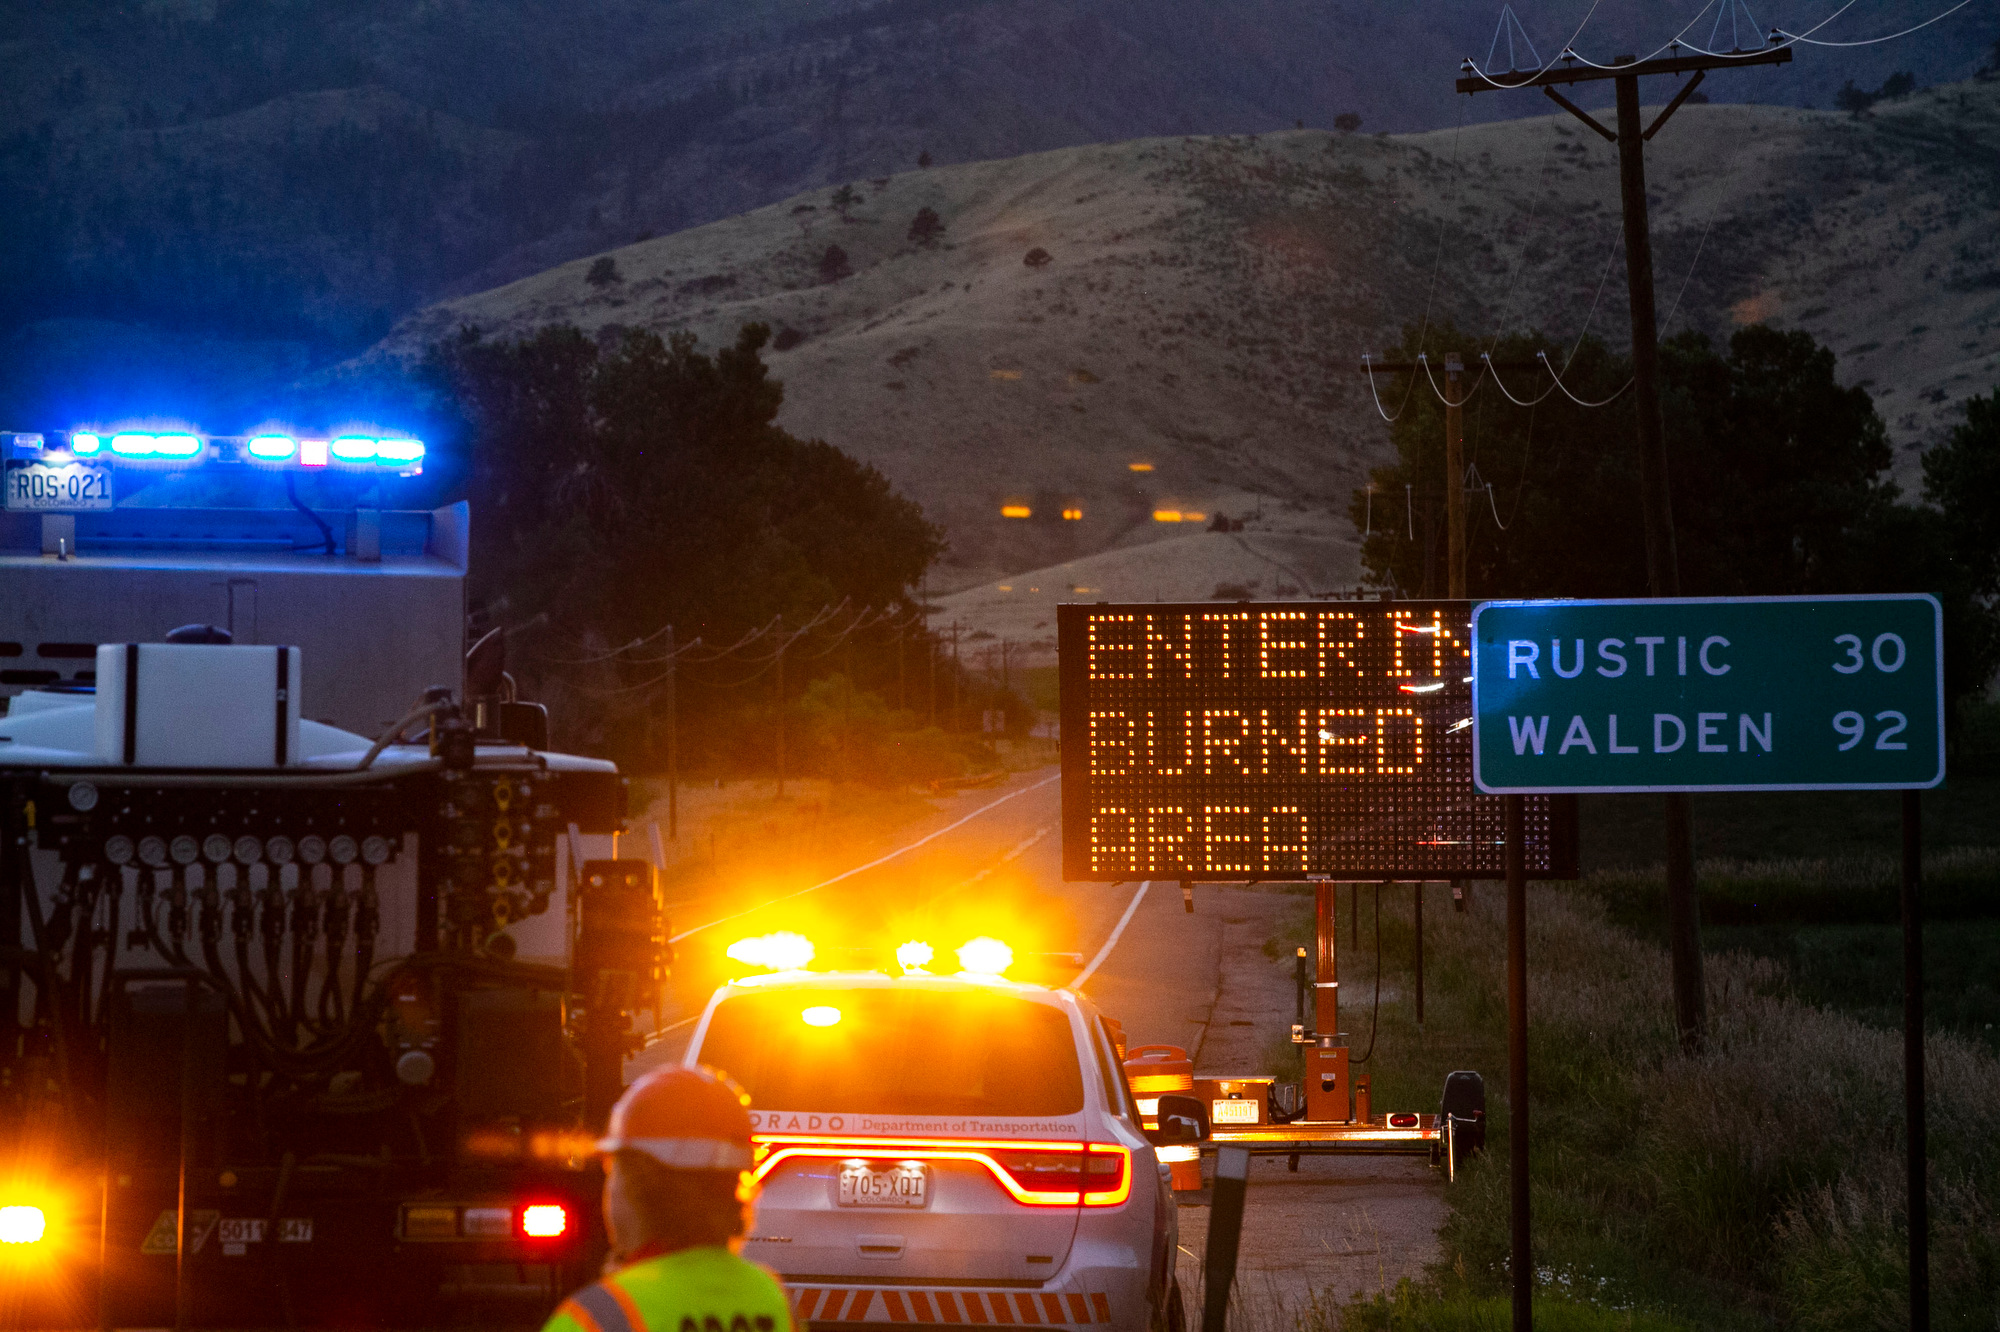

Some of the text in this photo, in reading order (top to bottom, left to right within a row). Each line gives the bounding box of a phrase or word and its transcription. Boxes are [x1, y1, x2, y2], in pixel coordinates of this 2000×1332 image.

[1508, 632, 1907, 679] RUSTIC 30
[1090, 708, 1422, 774] BURNED
[1508, 710, 1908, 755] WALDEN 92
[1091, 807, 1308, 872] AREA
[862, 1119, 948, 1133] Department
[951, 1120, 967, 1132] of
[969, 1121, 1077, 1134] Transportation
